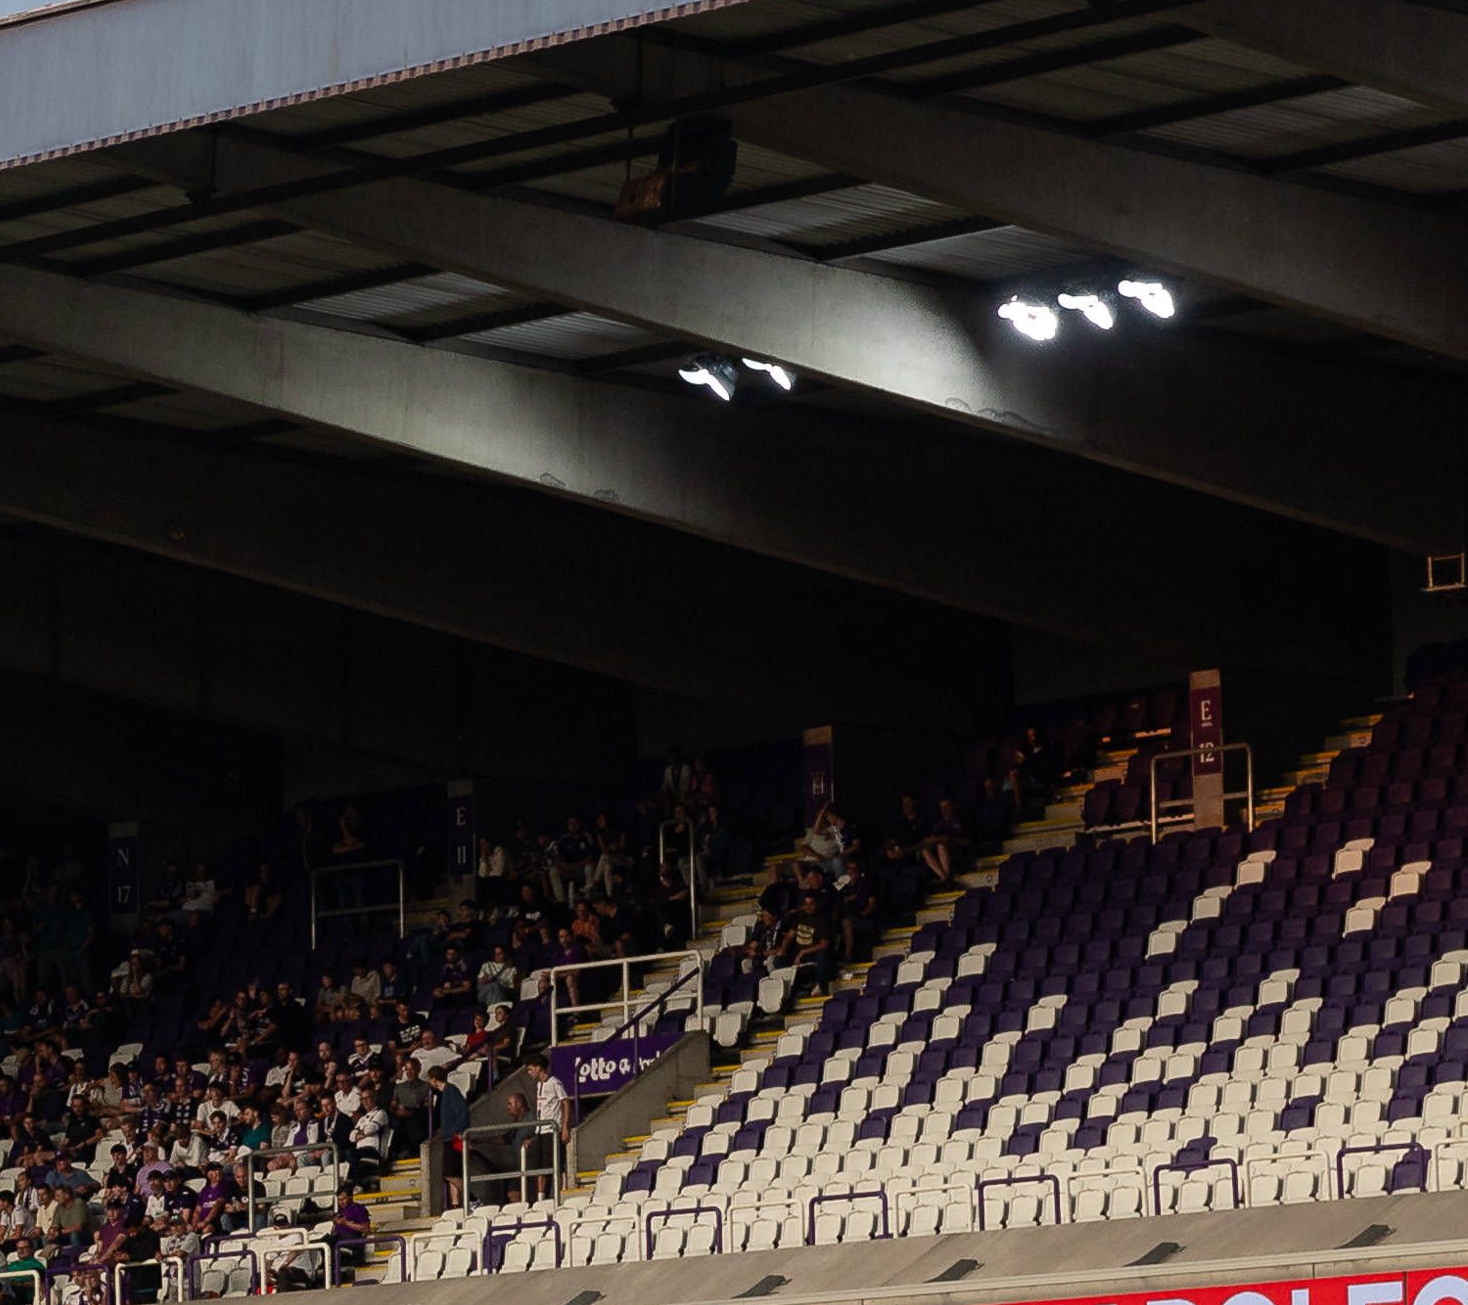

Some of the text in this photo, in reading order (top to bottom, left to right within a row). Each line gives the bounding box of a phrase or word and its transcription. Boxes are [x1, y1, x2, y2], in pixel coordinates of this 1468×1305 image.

[1201, 700, 1212, 721] E
[456, 807, 467, 826] E
[117, 847, 130, 867] N
[117, 885, 132, 903] 17
